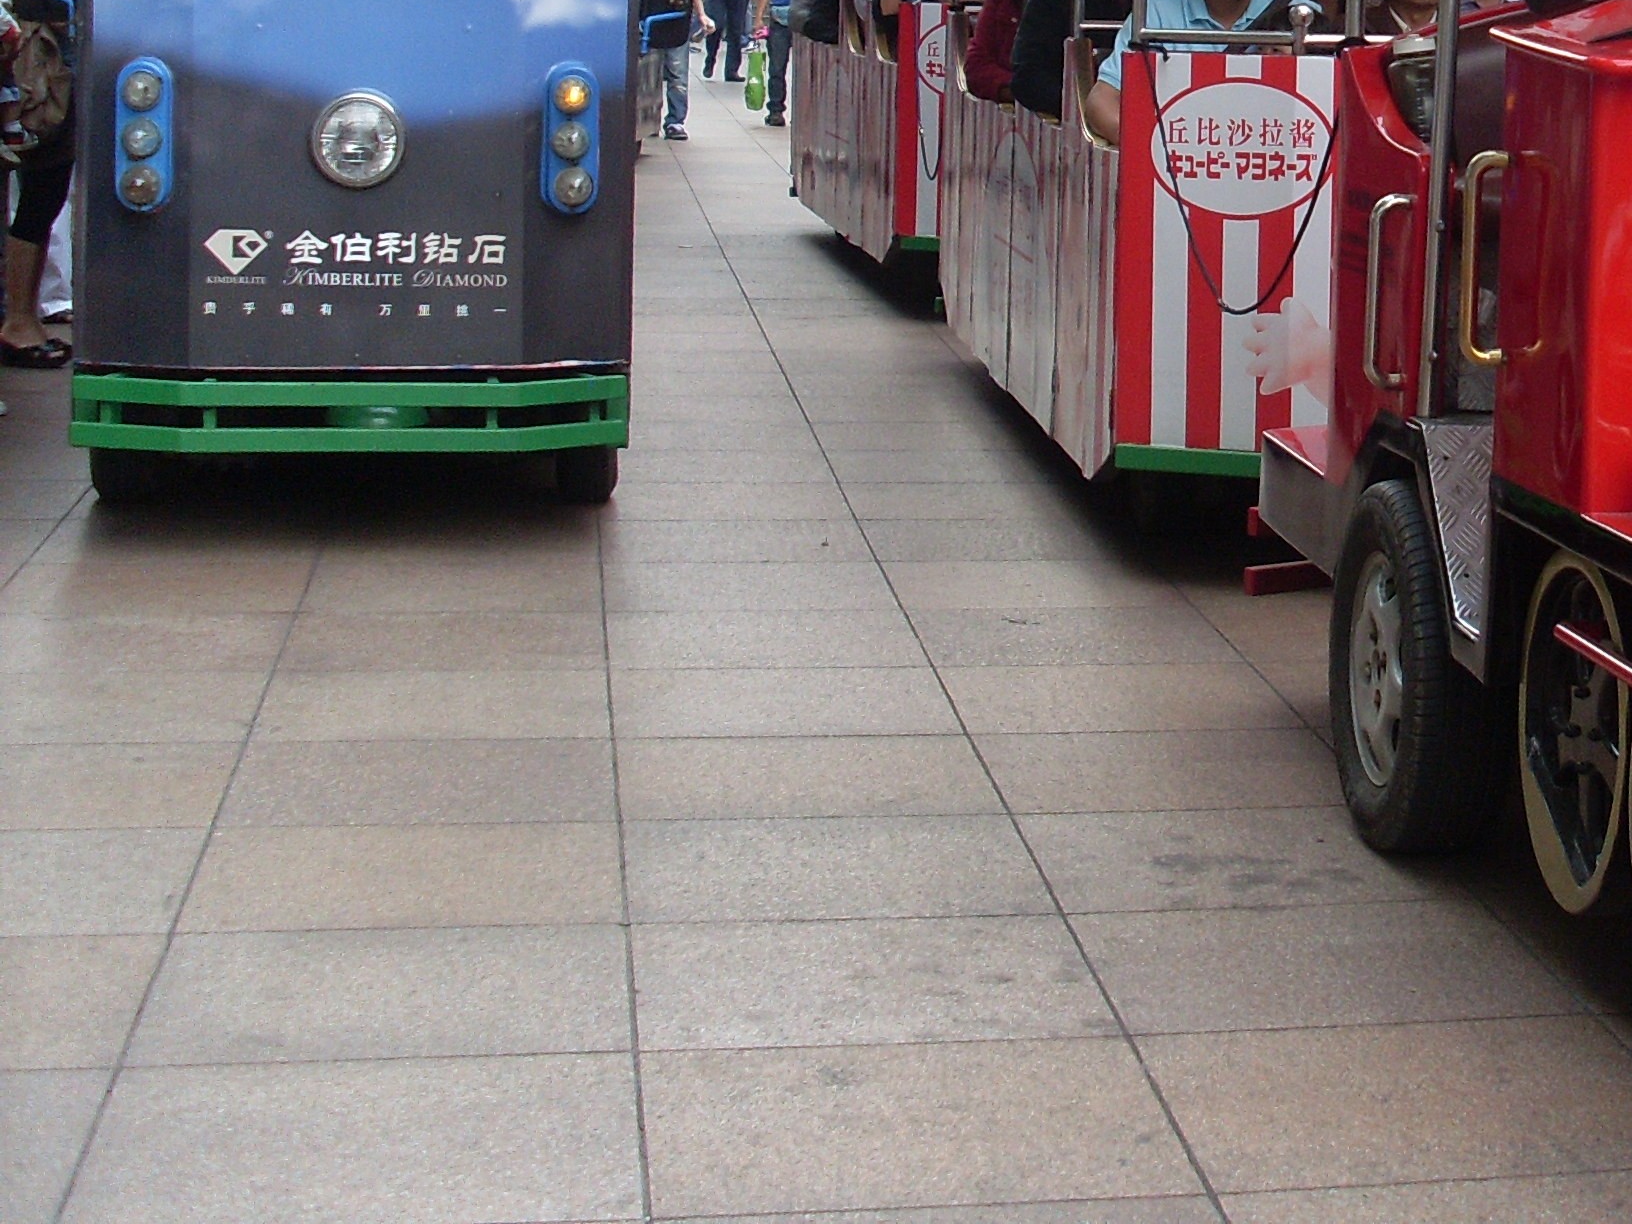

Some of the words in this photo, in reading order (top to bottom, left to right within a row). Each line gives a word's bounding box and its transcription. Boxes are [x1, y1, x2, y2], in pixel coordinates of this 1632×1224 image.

[1167, 116, 1316, 149] 丘比沙拉酱
[1235, 150, 1318, 182] マヨネーズ
[285, 229, 507, 264] 金伯利钻石
